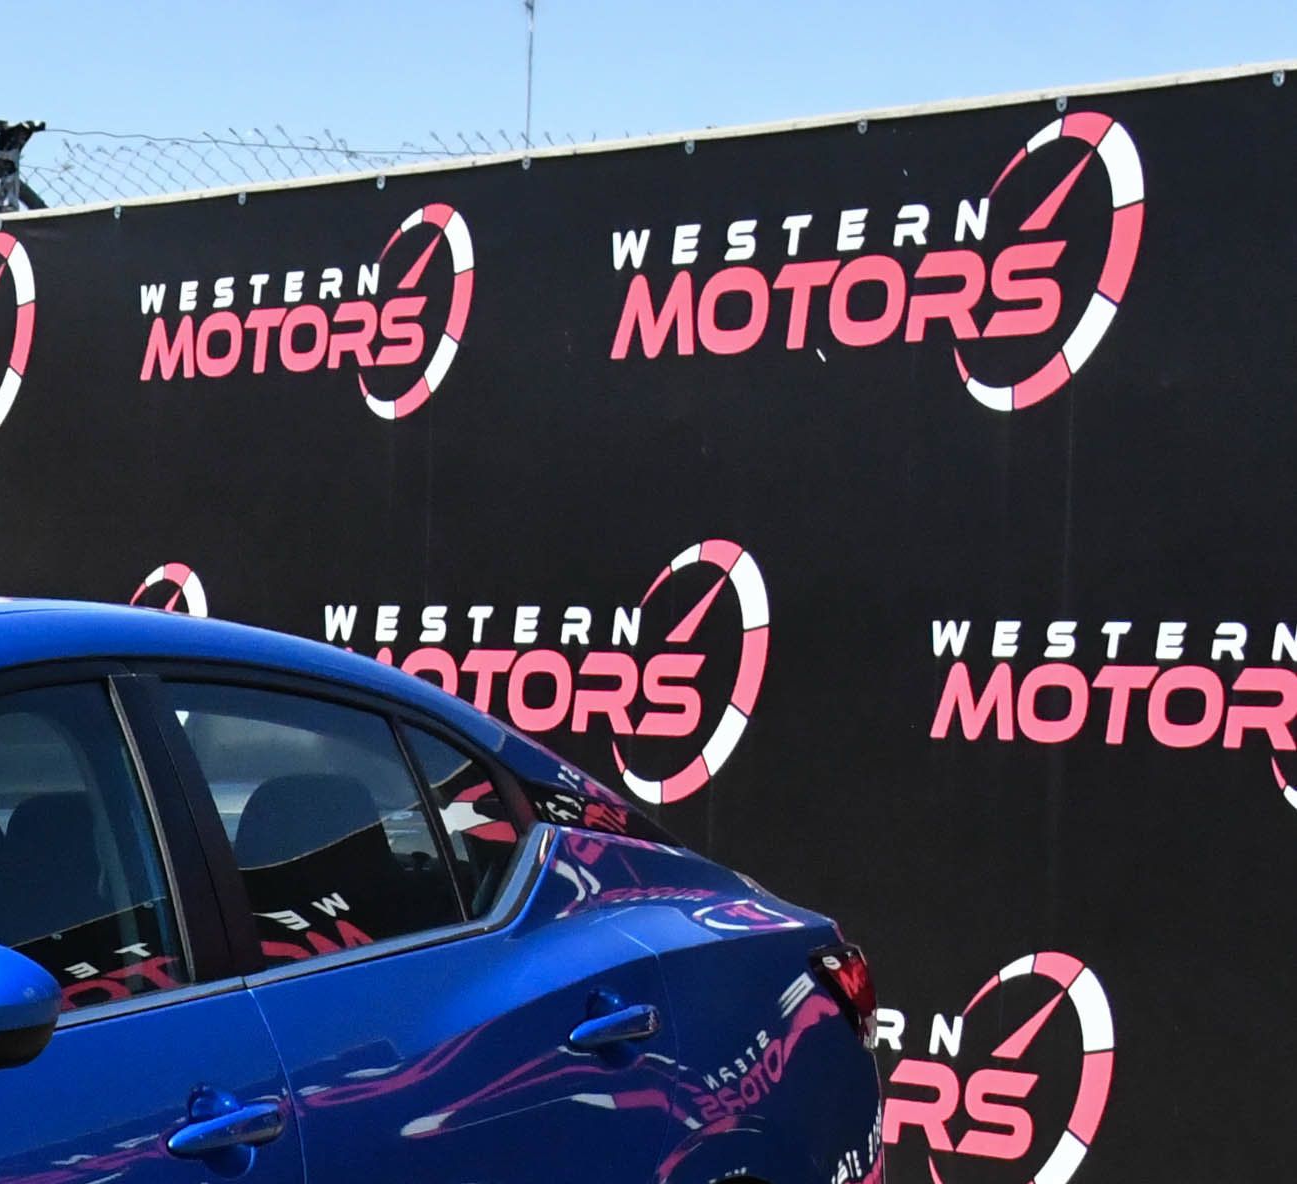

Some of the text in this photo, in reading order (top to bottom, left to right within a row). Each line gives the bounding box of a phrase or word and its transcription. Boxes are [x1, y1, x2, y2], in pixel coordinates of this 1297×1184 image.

[612, 197, 991, 271] WESTERN
[140, 262, 381, 315] WESTERN
[608, 239, 1069, 361] MOTORS
[139, 296, 429, 382] MOTORS
[323, 604, 642, 646] WESTERN
[931, 619, 1297, 662] WESTERN
[375, 645, 707, 738] OTORS
[929, 660, 1297, 752] MOTOR
